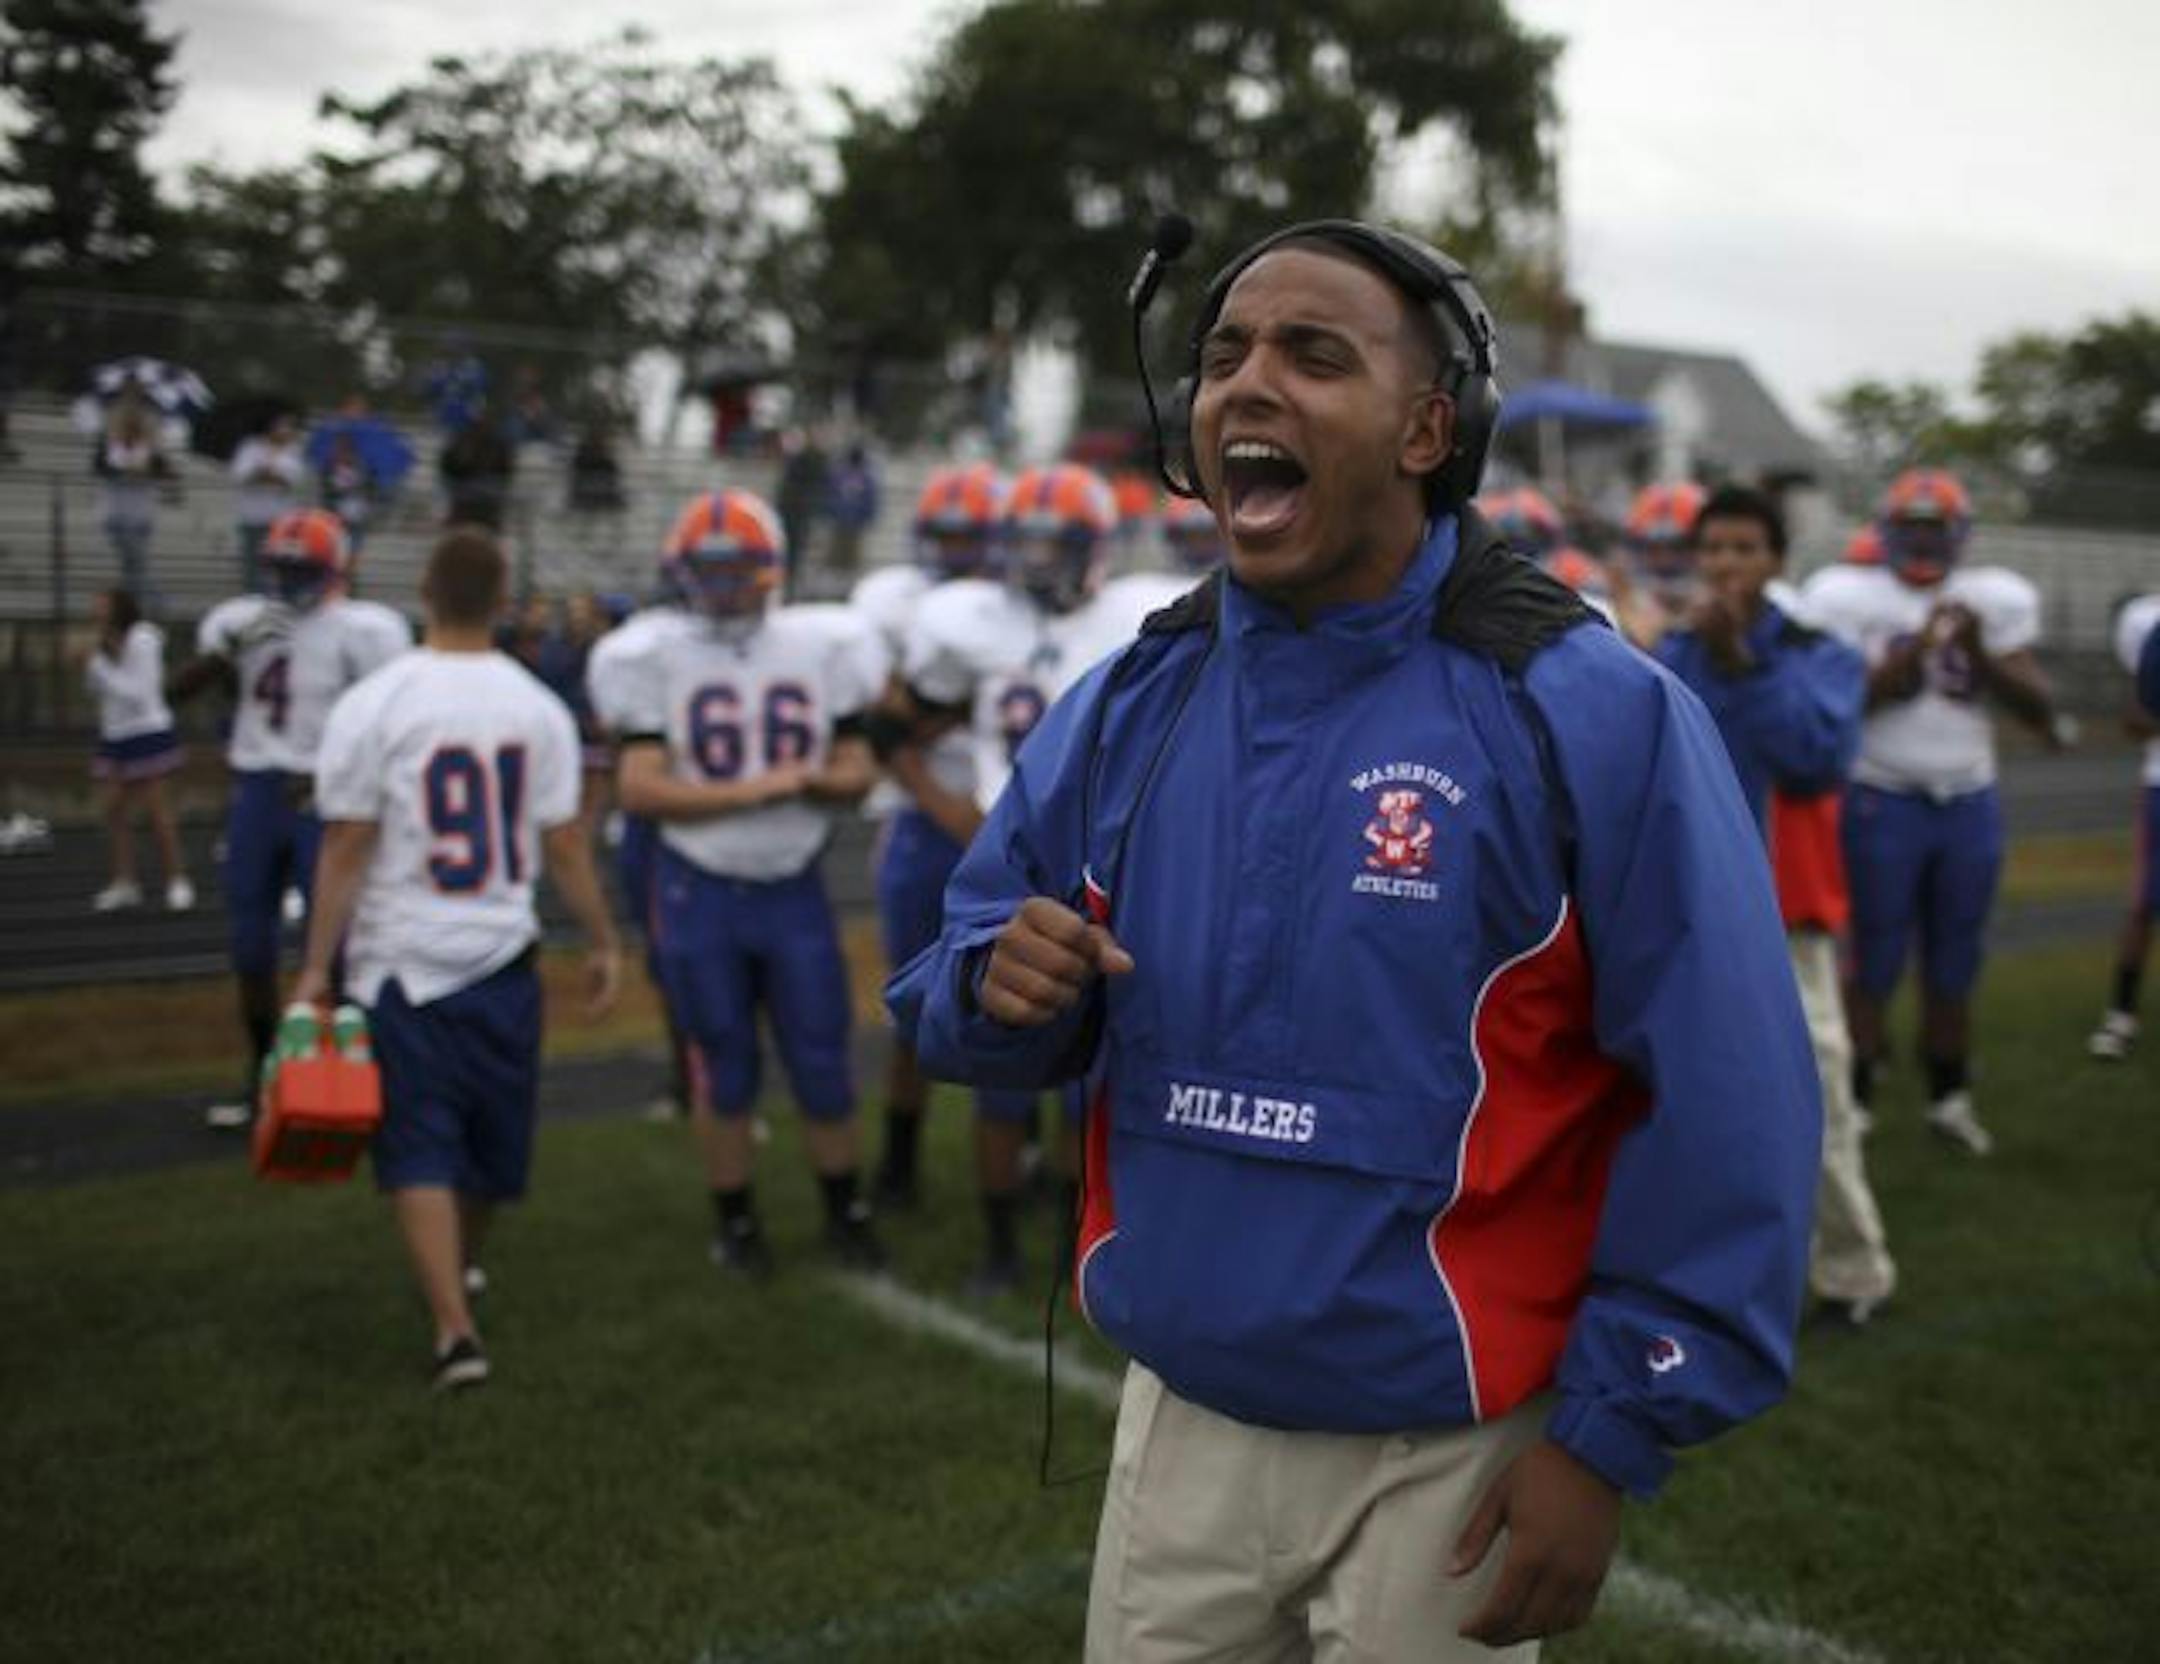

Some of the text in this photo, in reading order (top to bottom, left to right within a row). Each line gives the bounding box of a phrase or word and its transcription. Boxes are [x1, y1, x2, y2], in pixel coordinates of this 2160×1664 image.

[253, 653, 292, 734] 4
[687, 681, 815, 780] 66
[422, 740, 530, 895] 91
[1350, 763, 1465, 805] WASHBURN
[1165, 1082, 1317, 1143] MILLERS
